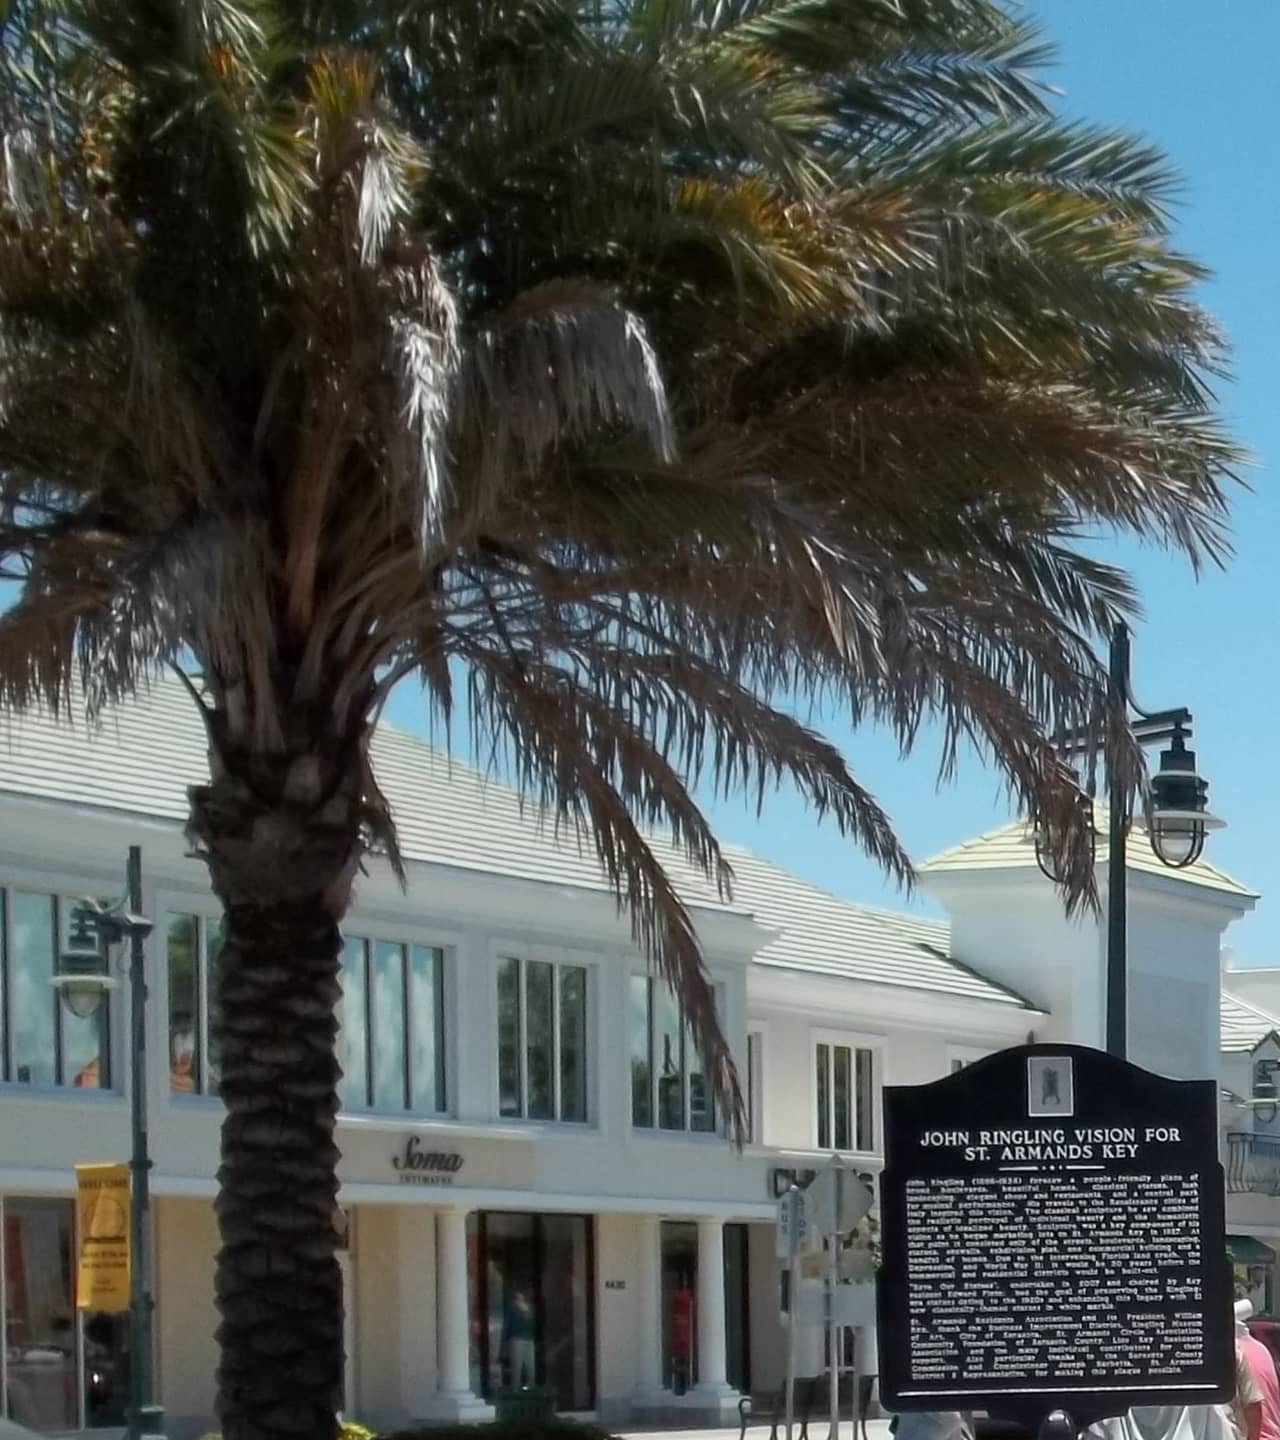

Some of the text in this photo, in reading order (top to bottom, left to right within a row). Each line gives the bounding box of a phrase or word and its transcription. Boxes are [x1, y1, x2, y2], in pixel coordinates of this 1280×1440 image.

[921, 1128, 1181, 1146] JOHN RINGLING VISION FOR
[392, 1135, 464, 1172] Soma
[965, 1144, 1139, 1160] ST. ARMANDS KEY
